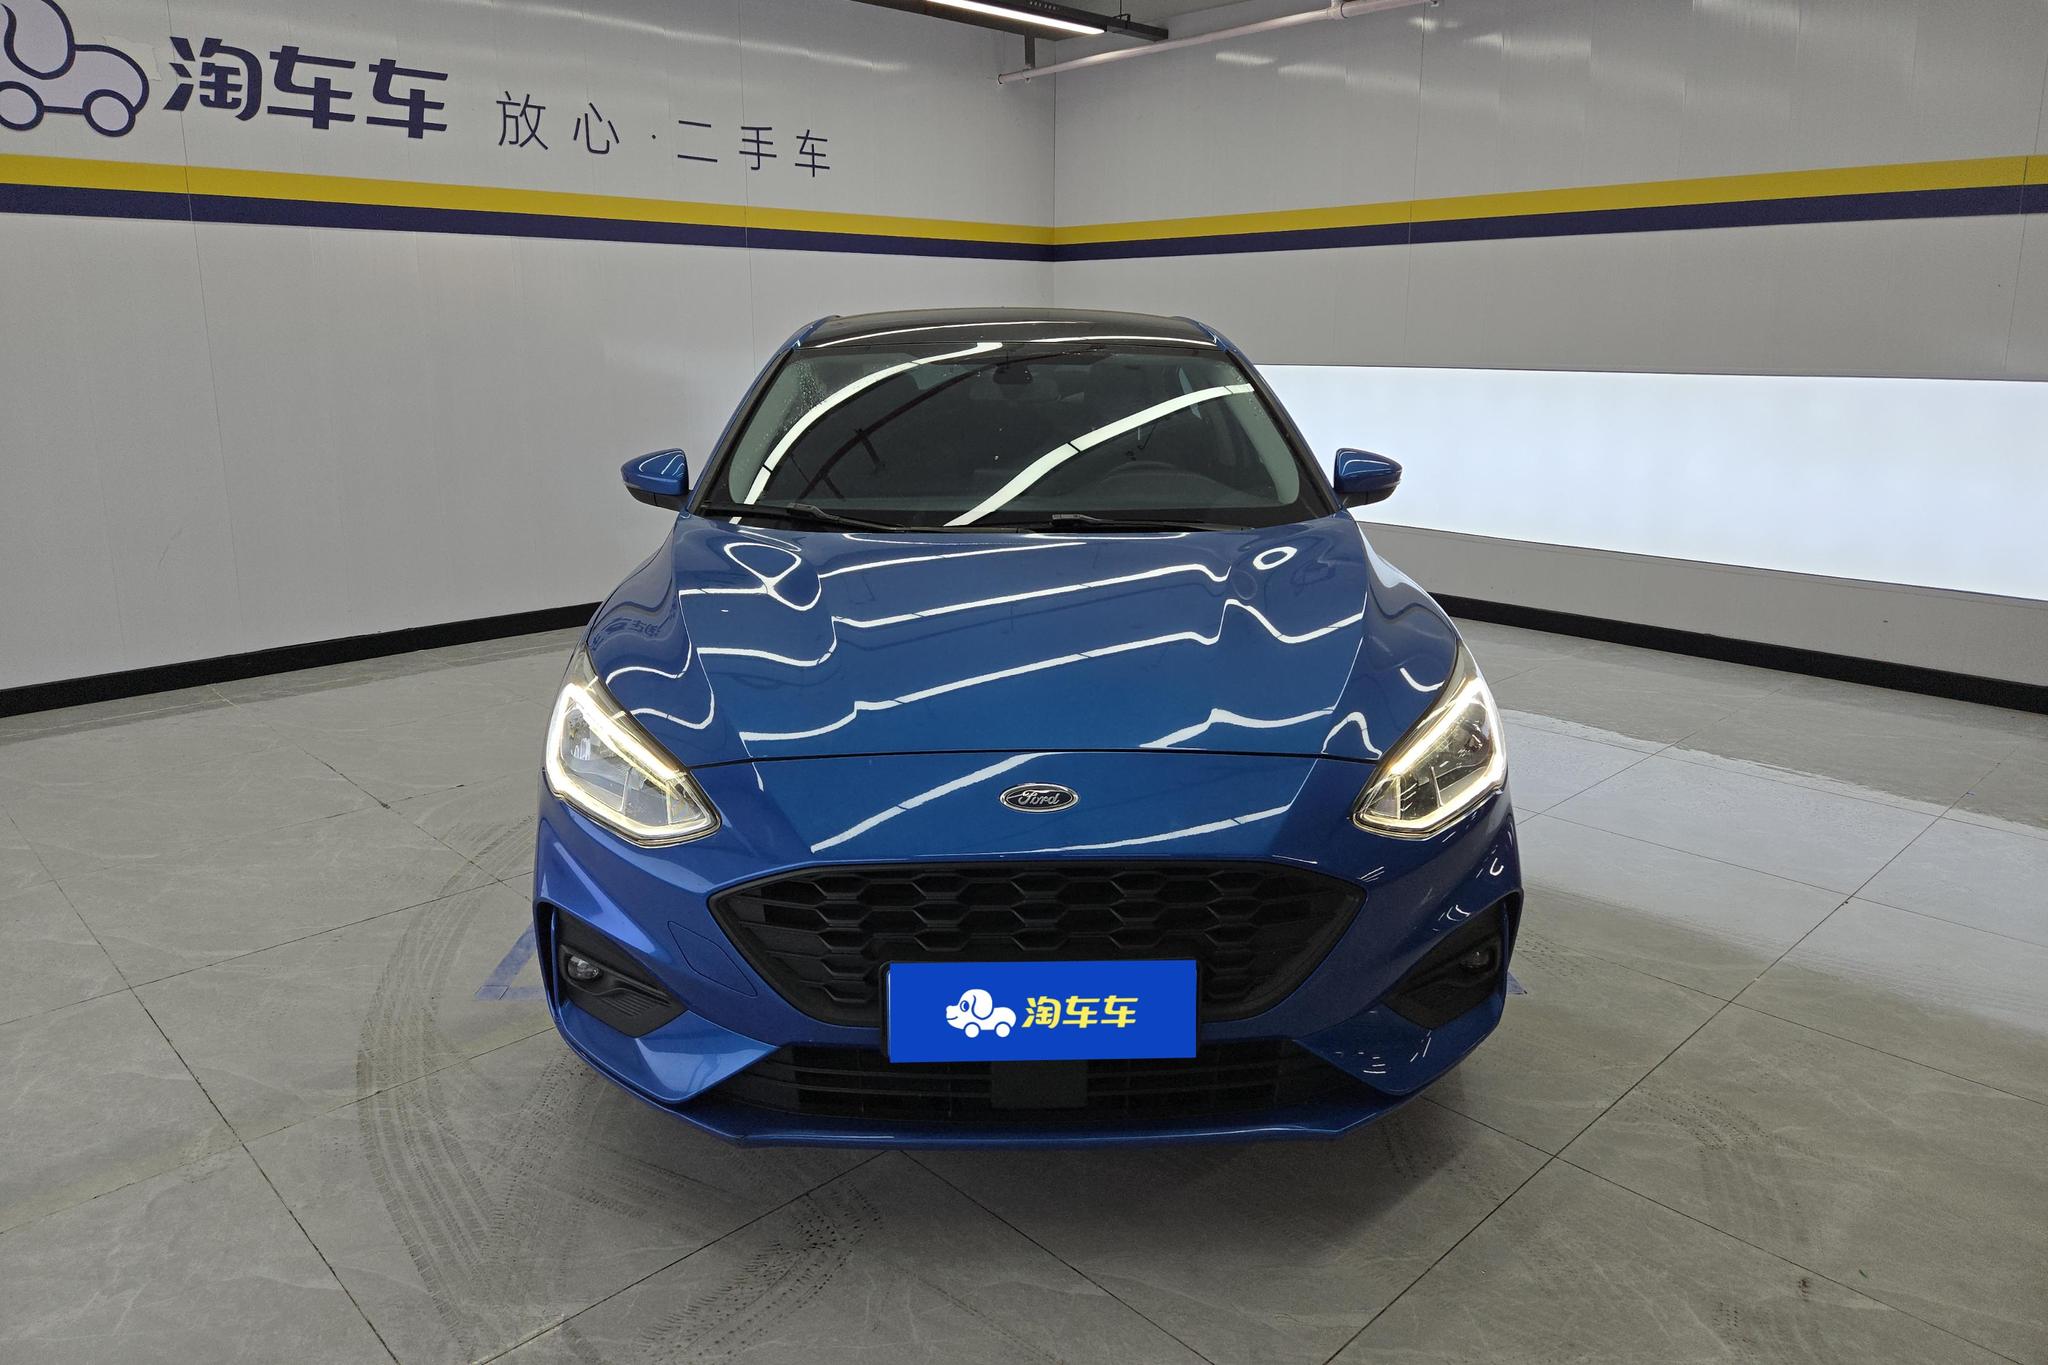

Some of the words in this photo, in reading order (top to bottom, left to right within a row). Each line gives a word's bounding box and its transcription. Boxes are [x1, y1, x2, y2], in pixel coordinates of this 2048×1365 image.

[163, 36, 448, 139] 淘车车
[1013, 788, 1062, 806] Ford
